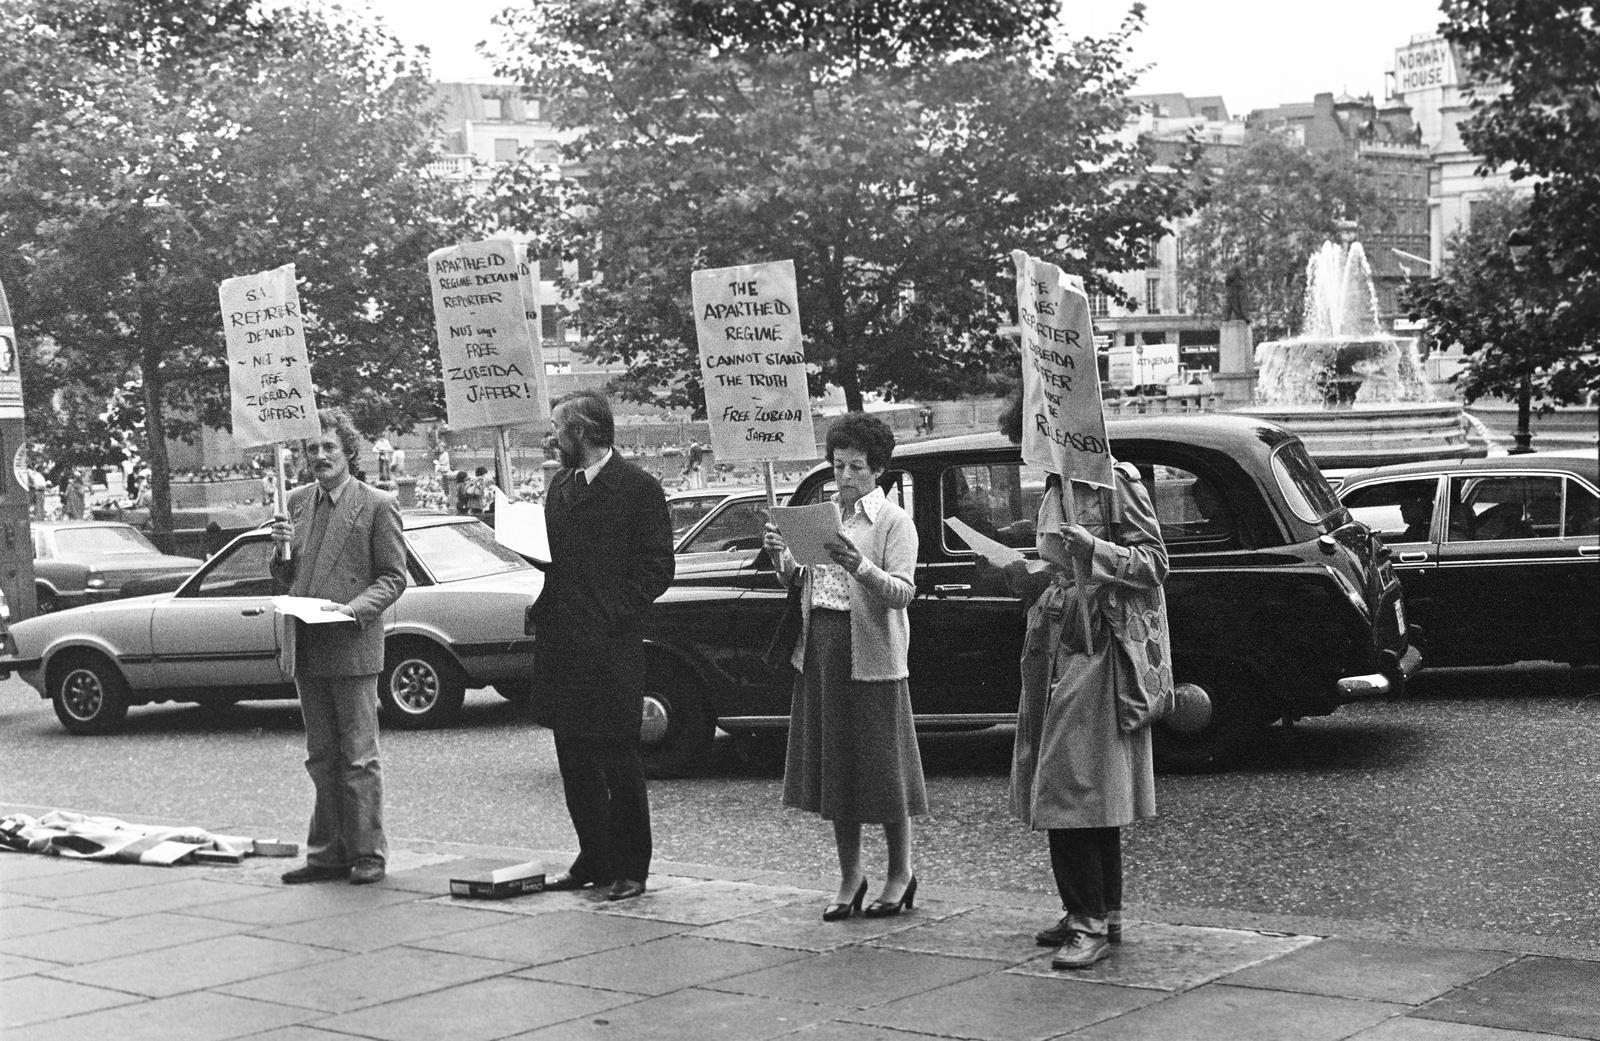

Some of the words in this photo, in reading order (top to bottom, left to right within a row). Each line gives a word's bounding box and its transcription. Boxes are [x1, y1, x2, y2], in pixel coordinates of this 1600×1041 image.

[1399, 48, 1446, 69] NORWAY
[1403, 67, 1443, 88] HOUSE
[435, 253, 506, 275] APARTHEID
[439, 275, 472, 290] REGIME
[729, 281, 758, 296] THE
[443, 291, 503, 309] REPORTER
[703, 299, 791, 320] APARTHEID
[449, 324, 473, 339] NUJ
[724, 325, 783, 341] REGIME
[1021, 307, 1081, 348] REPRTER
[465, 342, 500, 359] FREE
[706, 353, 761, 369] CANNOT
[765, 351, 805, 365] STAND
[1137, 356, 1174, 366] ATHENA
[447, 363, 525, 381] ZUBEIDA
[715, 375, 743, 386] THE
[746, 374, 788, 388] TRUTH
[466, 382, 531, 403] JAFFER!
[745, 428, 785, 443] JAFFER
